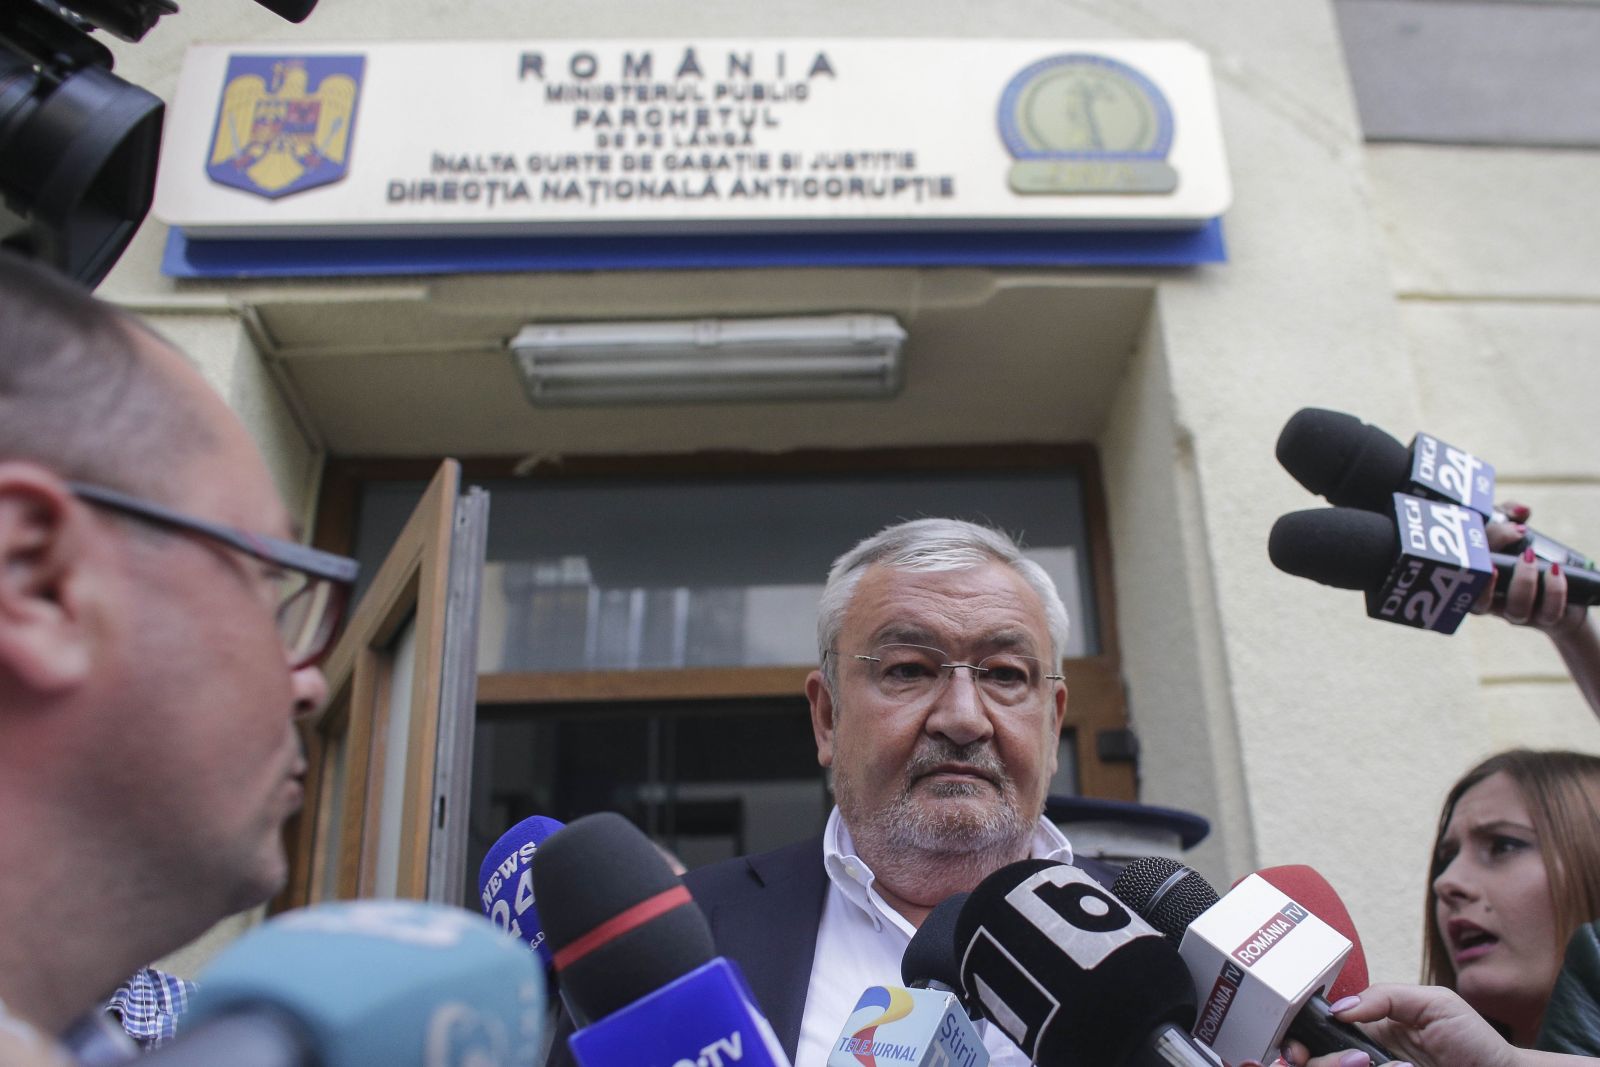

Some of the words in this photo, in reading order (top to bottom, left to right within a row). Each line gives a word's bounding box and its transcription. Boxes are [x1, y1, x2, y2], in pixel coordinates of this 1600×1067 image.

[518, 47, 836, 79] ROMÂNIA
[546, 83, 704, 103] MINISTERUL
[714, 83, 808, 102] PUBLIC
[573, 107, 778, 128] PARCHETUL
[596, 132, 625, 149] DE
[635, 132, 663, 148] PE
[526, 153, 611, 173] CURTE
[621, 153, 653, 172] DE
[1419, 435, 1438, 482] DIGI
[1437, 446, 1483, 507] 24
[1404, 498, 1427, 551] DIGI
[1428, 502, 1471, 568] 24
[1468, 527, 1485, 549] HD
[1380, 560, 1424, 617] DIGI
[1403, 566, 1477, 631] 24
[1451, 592, 1473, 614] HD
[482, 841, 538, 913] NEWS
[1238, 917, 1291, 964] ROMÂNIA
[1285, 904, 1304, 922] TV
[1199, 984, 1234, 1045] ROMÂNIA
[1224, 963, 1242, 986] TV
[838, 1036, 917, 1063] TELEJURNAL
